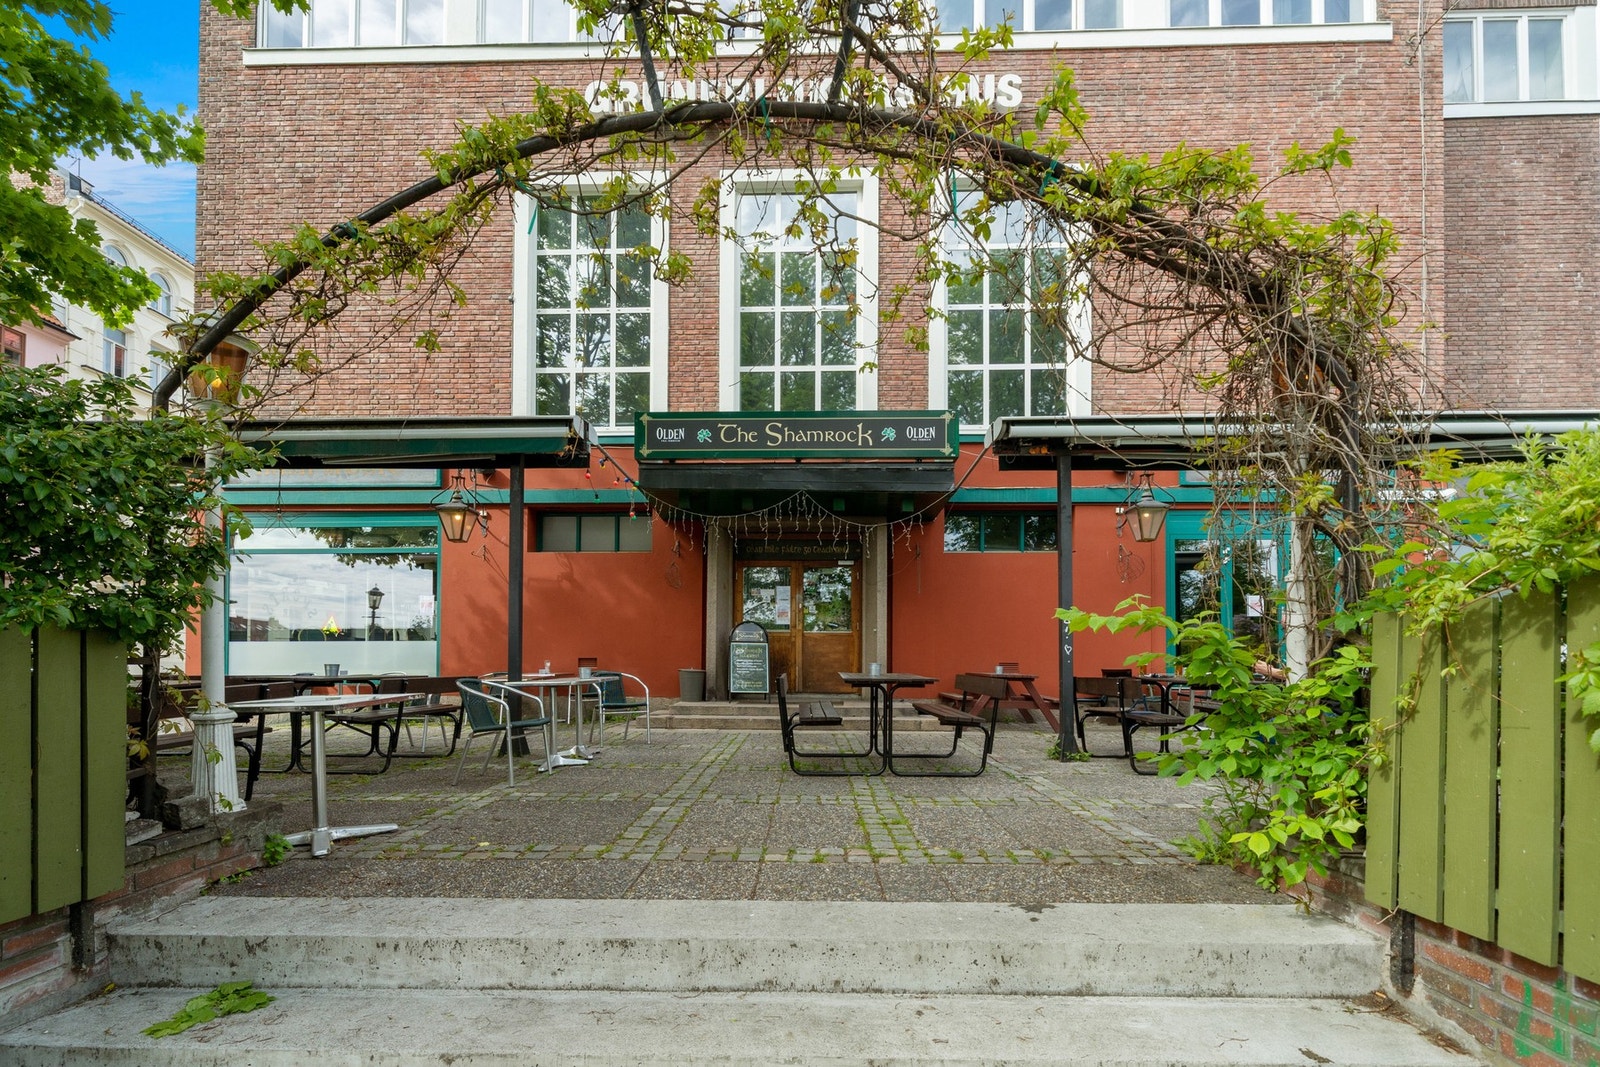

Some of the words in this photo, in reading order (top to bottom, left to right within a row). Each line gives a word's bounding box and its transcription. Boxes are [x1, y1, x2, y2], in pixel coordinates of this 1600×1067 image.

[656, 427, 685, 440] OLDEN
[717, 423, 758, 443] The
[764, 422, 873, 447] Shamrock
[906, 425, 936, 439] OLDEN
